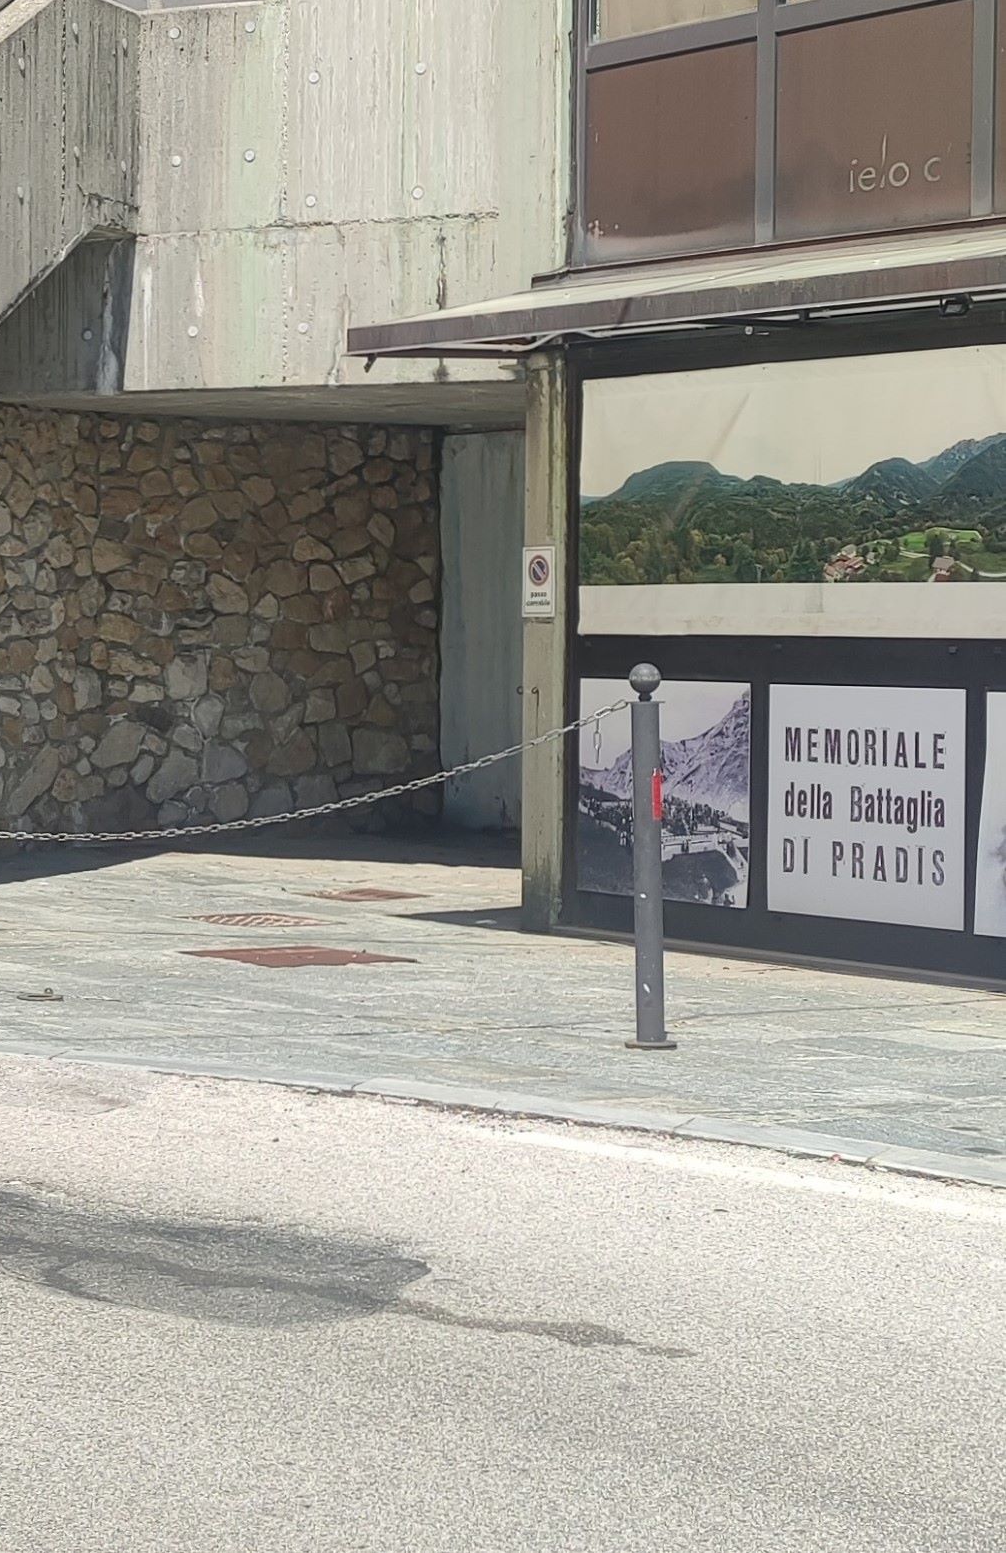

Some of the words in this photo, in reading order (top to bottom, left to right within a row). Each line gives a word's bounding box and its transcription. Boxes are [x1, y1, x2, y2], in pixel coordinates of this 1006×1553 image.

[785, 726, 946, 770] MEMORIALE
[784, 781, 833, 820] della
[850, 785, 945, 834] Battaglia
[782, 837, 810, 875] DI
[832, 840, 945, 887] PRADIS
